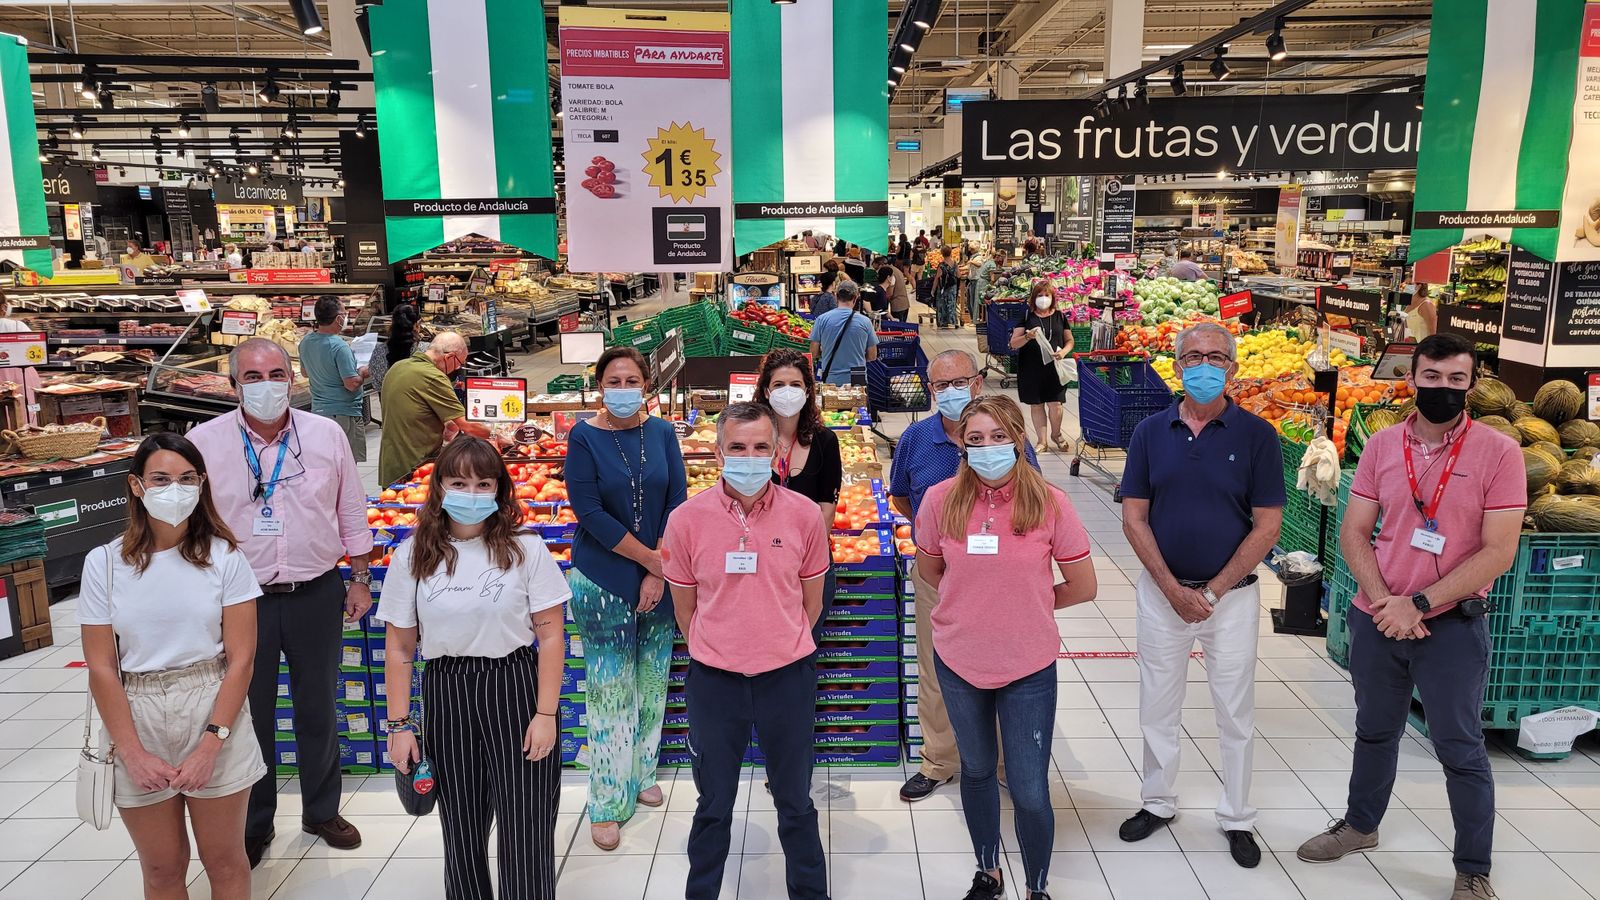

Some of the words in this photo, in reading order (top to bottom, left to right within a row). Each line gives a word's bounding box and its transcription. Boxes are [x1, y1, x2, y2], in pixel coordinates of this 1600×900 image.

[566, 49, 592, 58] PRECIOS
[593, 50, 630, 59] IMBATIBLES
[635, 47, 666, 60] PARA
[669, 49, 723, 62] AYUDARTE
[982, 120, 1062, 160] Las
[1074, 115, 1219, 159] frutas
[1231, 125, 1259, 167] y
[656, 148, 672, 186] 1
[680, 149, 692, 166] €
[681, 170, 707, 187] 35
[234, 183, 246, 199] La
[246, 184, 287, 201] carnicería
[413, 202, 459, 213] Producto
[463, 202, 476, 212] de
[478, 201, 529, 212] Andalucía
[761, 206, 803, 216] Producto
[805, 205, 818, 215] de
[819, 204, 864, 214] Andalucía
[1438, 214, 1479, 226] Producto
[1481, 215, 1493, 225] de
[1493, 213, 1536, 225] Andalucía
[10, 238, 38, 247] Andalucía
[673, 243, 701, 252] Producto
[677, 250, 707, 258] Andalucía
[1325, 295, 1346, 309] Naranja
[1346, 298, 1353, 309] de
[1353, 303, 1370, 312] zumo
[1450, 315, 1484, 334] Naranja
[1485, 321, 1498, 334] de
[80, 497, 128, 514] Producto
[427, 571, 473, 603] Dream
[478, 566, 506, 603] Big
